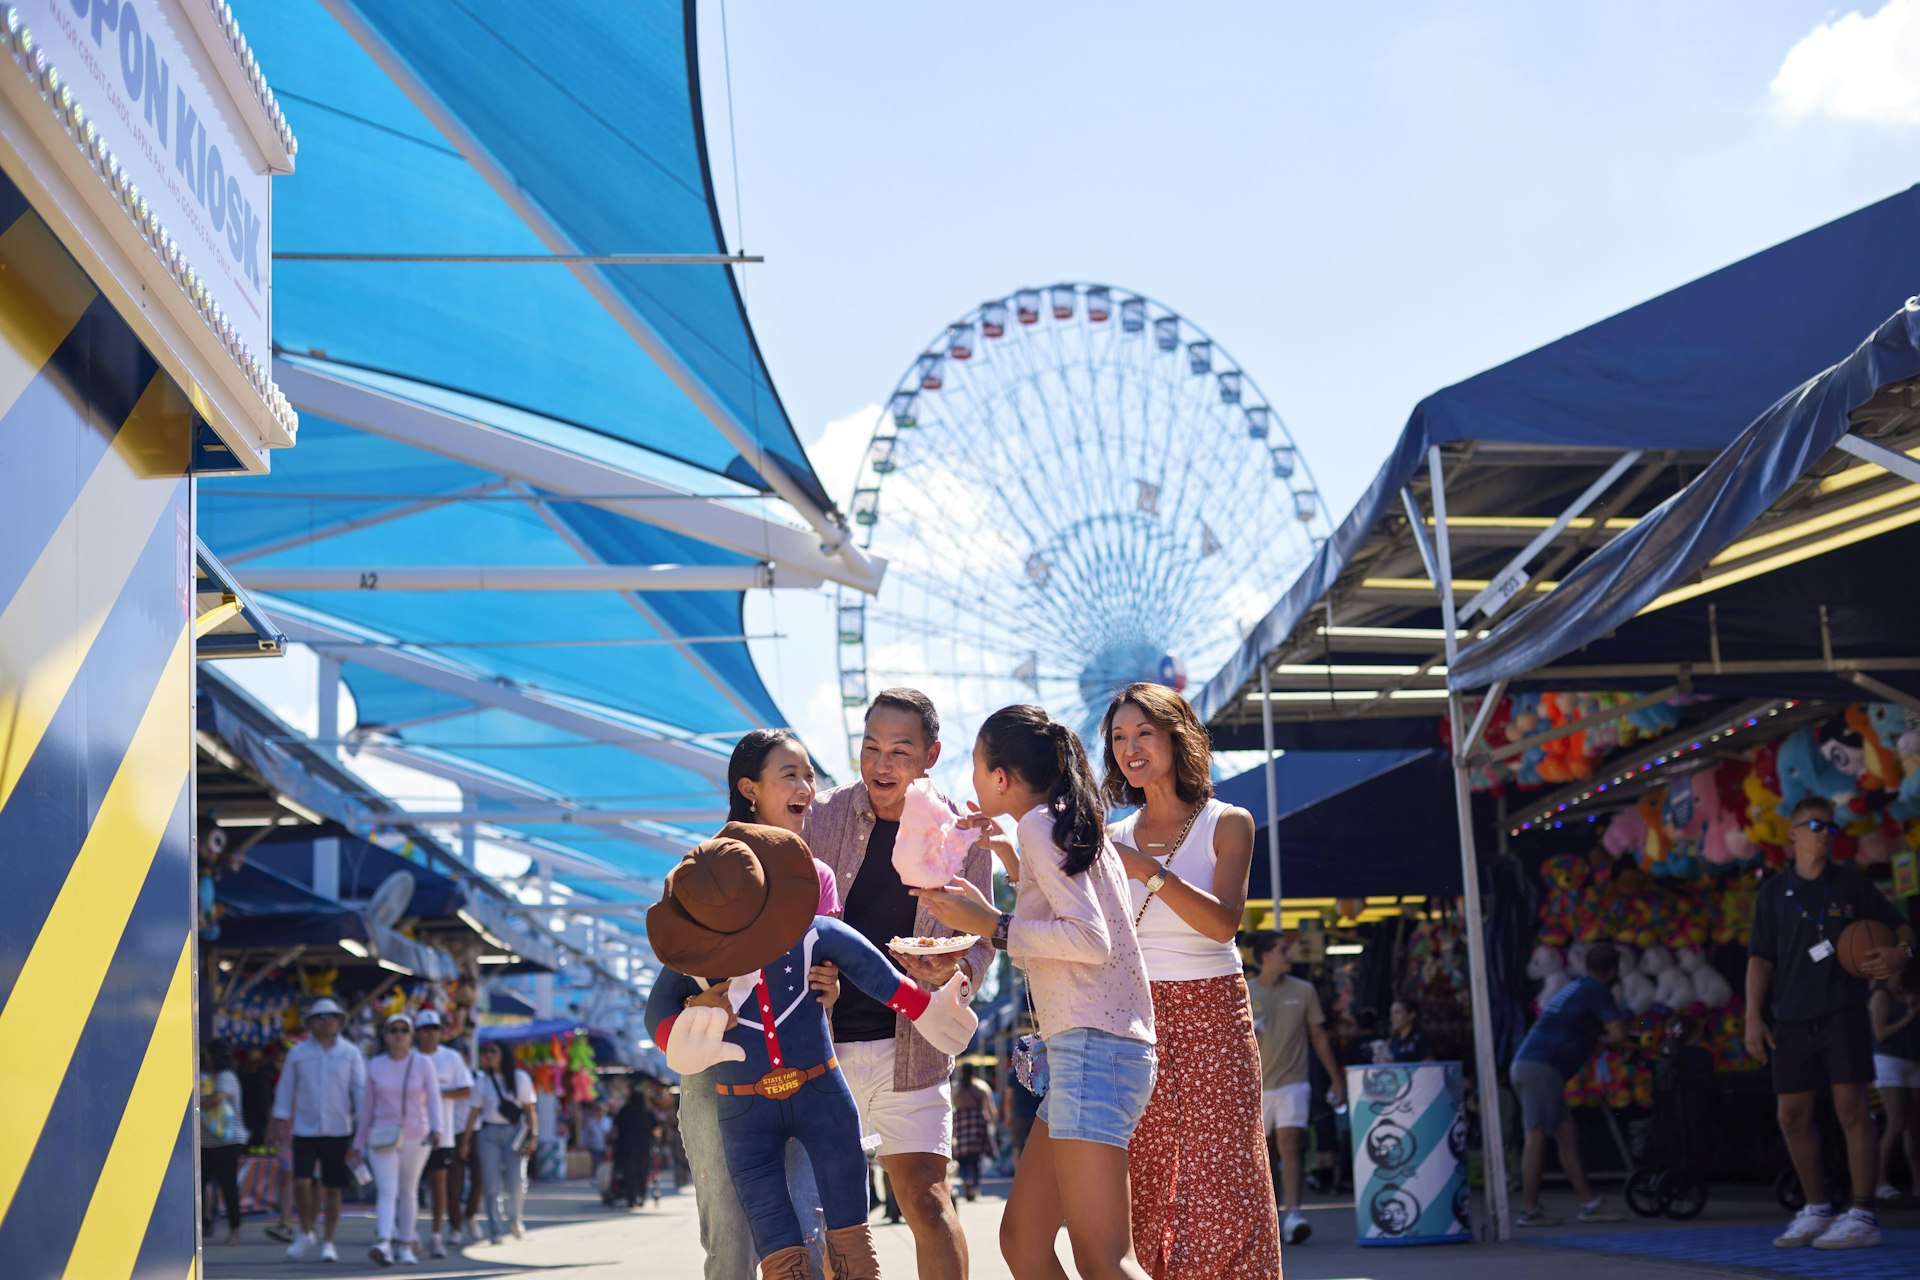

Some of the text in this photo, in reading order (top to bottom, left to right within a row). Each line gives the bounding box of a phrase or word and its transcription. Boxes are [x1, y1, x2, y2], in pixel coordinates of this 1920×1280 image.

[49, 0, 77, 50] MAJOR
[79, 39, 106, 91] CREDIT
[133, 123, 153, 164] APPLE
[167, 175, 180, 204] AND
[182, 195, 205, 241] GOOGLE
[205, 231, 215, 257] PAY
[175, 84, 261, 296] KIOSK
[177, 535, 189, 595] 05
[360, 571, 378, 590] A2
[763, 1072, 797, 1084] STATE FAIR
[765, 1080, 798, 1094] TEXAS
